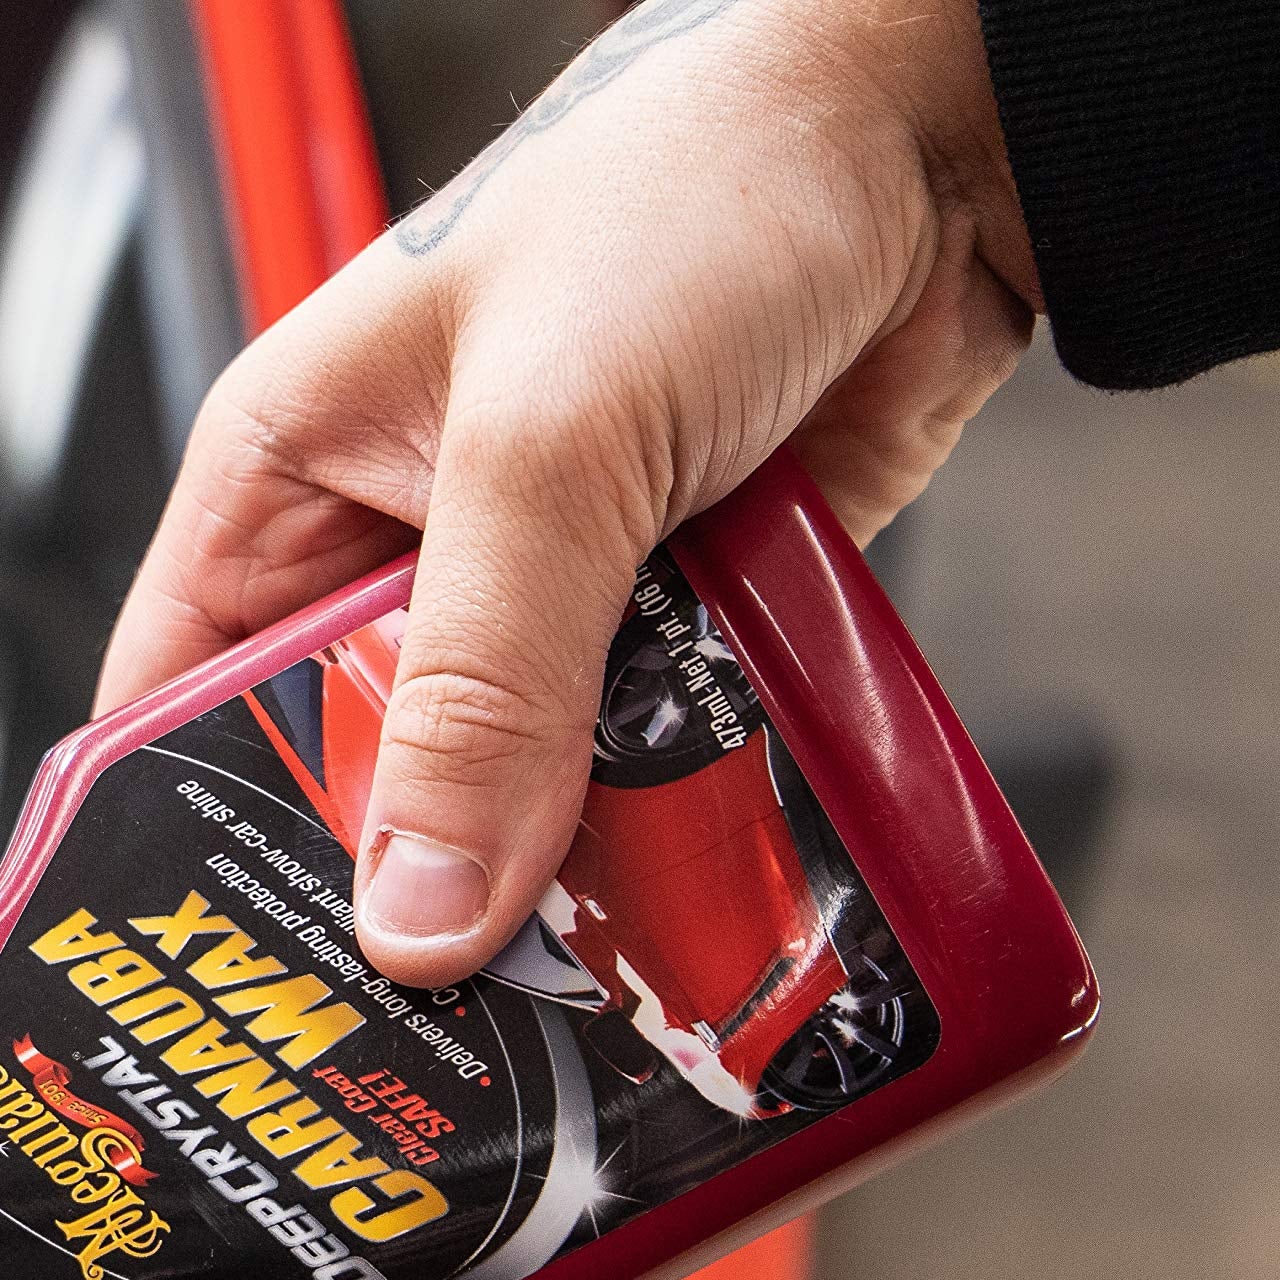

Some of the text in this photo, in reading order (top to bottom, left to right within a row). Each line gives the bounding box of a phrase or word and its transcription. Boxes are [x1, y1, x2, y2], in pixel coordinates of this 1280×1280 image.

[634, 583, 672, 616] (16
[655, 611, 691, 641] pt.
[668, 640, 694, 658] 1
[678, 654, 716, 694] Net
[697, 685, 748, 750] 473mL
[176, 780, 236, 822] shine
[224, 820, 322, 892] show-car
[127, 888, 368, 1073] WAX
[205, 852, 488, 1080] Delivers long-lasting protection
[28, 907, 450, 1245] CARNAUBA
[38, 1078, 109, 1125] Since 1901
[357, 1067, 456, 1138] SAFE!
[311, 1064, 440, 1166] Clear Coat
